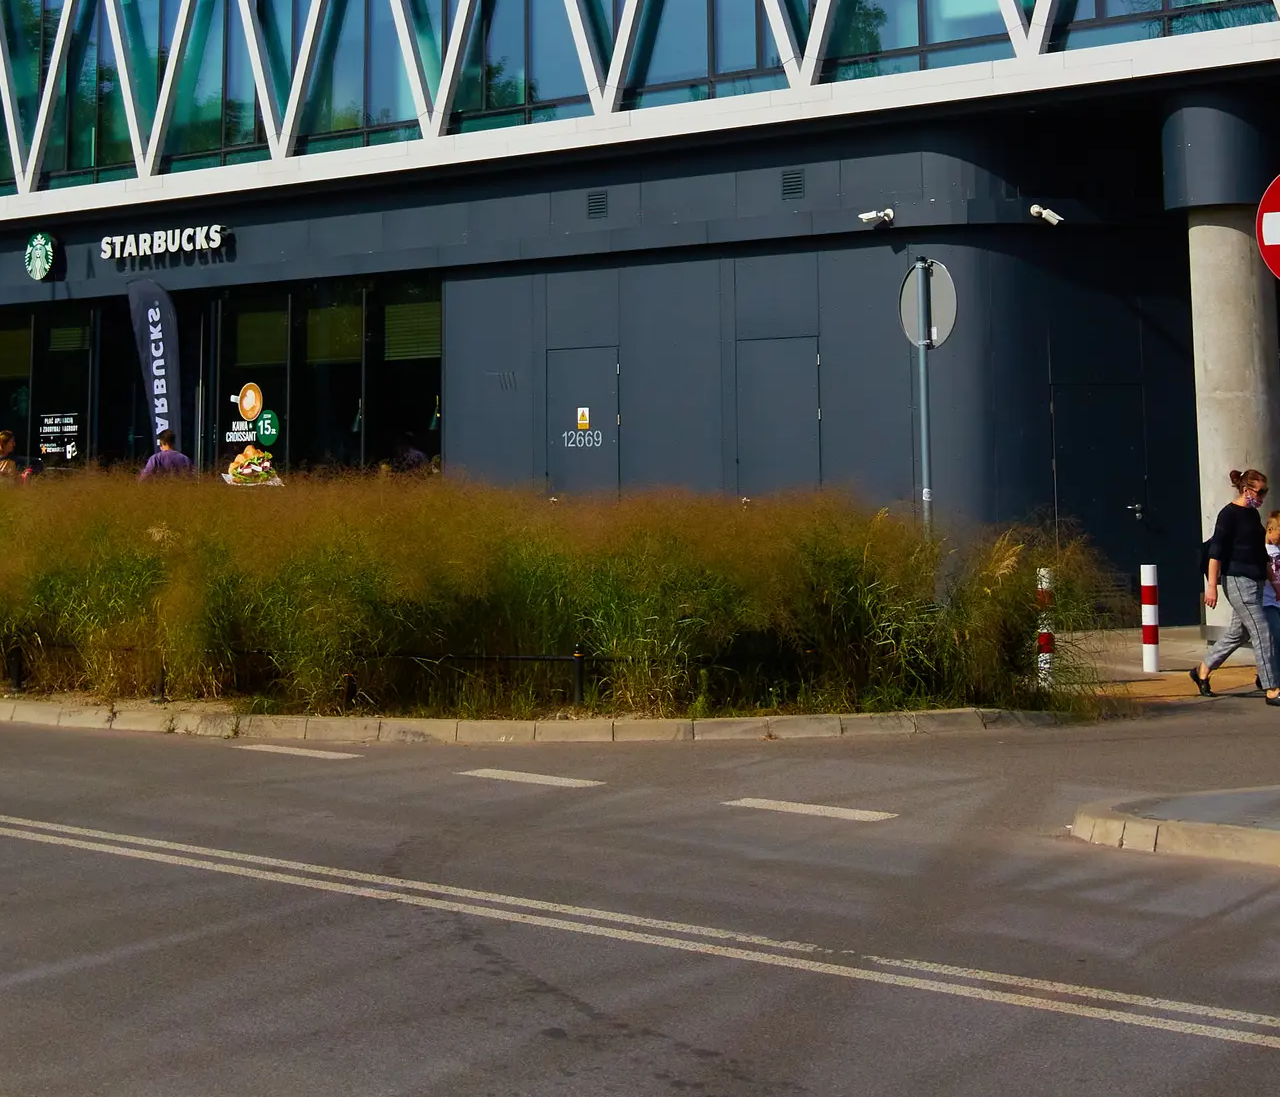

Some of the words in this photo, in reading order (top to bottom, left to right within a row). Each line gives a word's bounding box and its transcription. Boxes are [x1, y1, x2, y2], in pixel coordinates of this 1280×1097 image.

[100, 224, 221, 259] STARBUCKS
[258, 420, 271, 435] 15
[225, 432, 257, 442] CROISSANT
[562, 430, 602, 447] 12669
